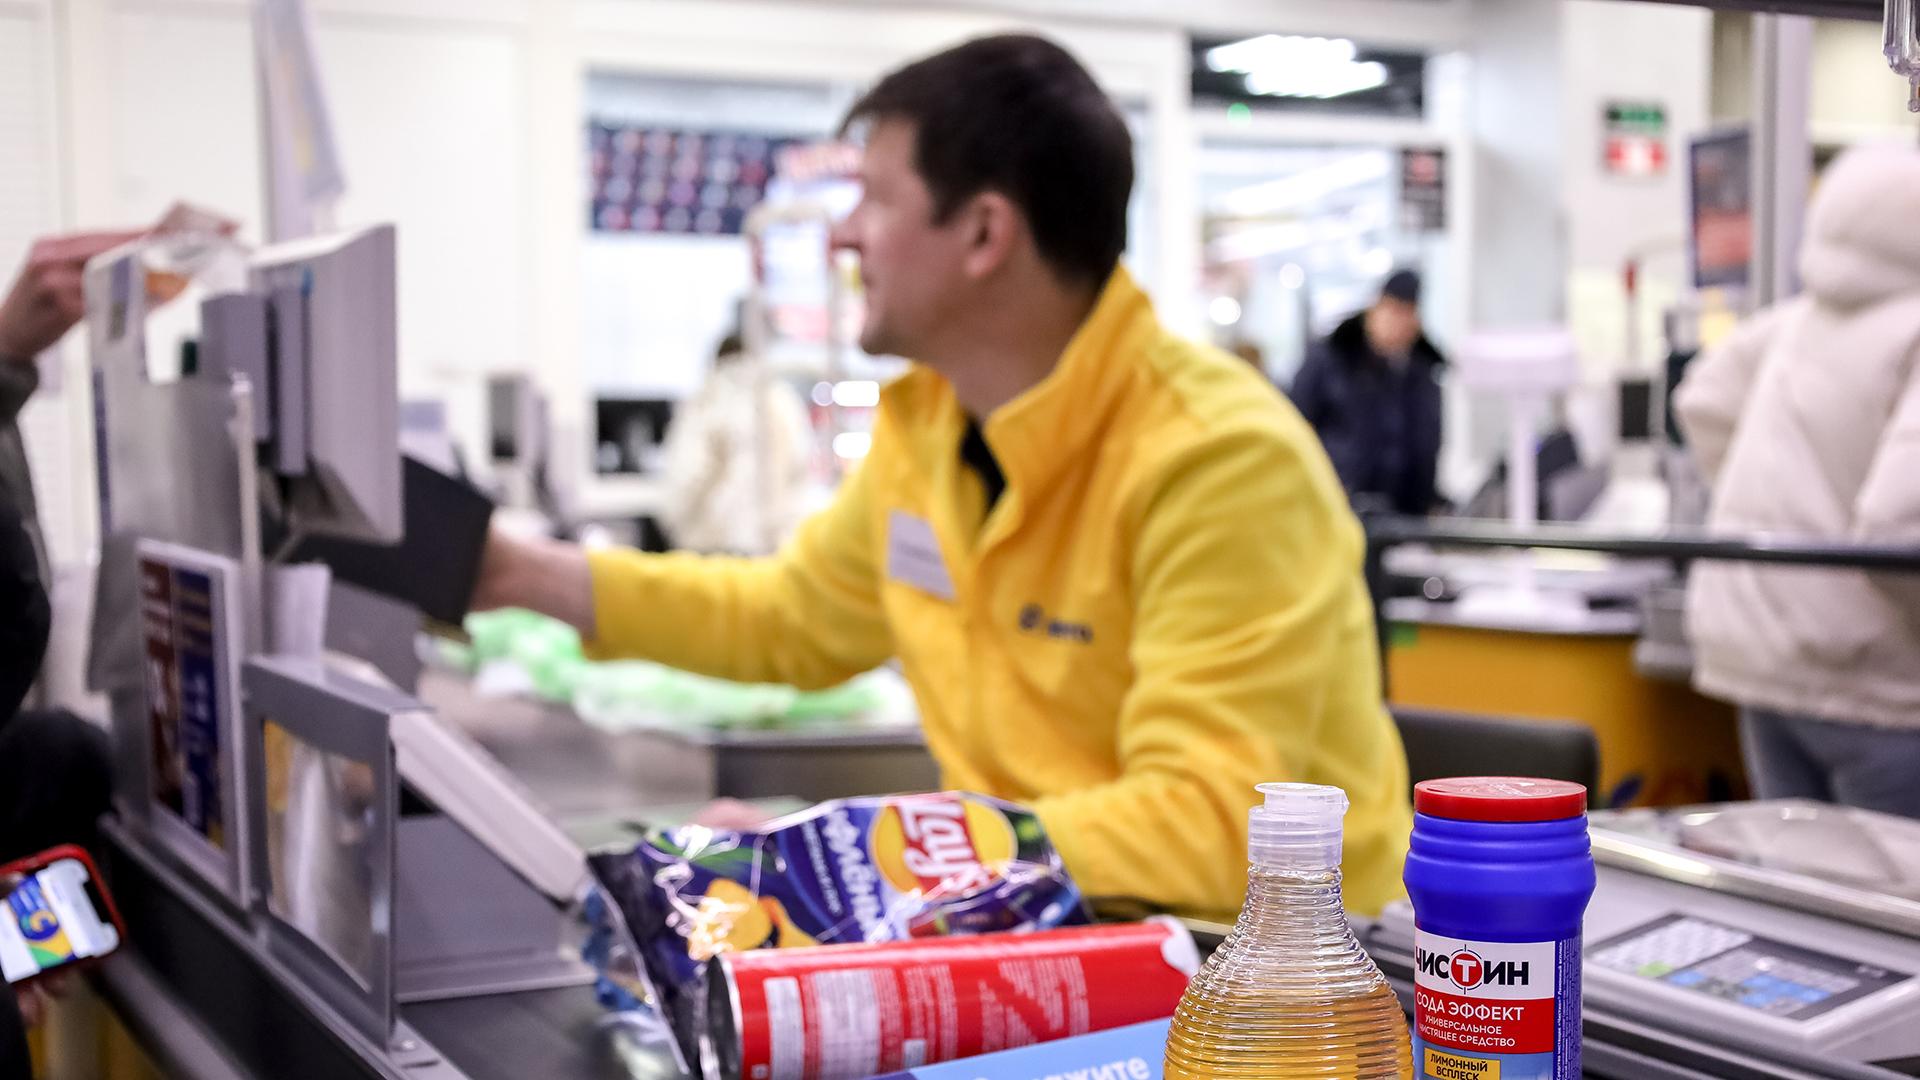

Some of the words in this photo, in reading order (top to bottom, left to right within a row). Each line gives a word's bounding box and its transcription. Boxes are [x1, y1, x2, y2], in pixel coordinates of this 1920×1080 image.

[1415, 945, 1529, 986] ЧИСТИН
[1416, 991, 1445, 1014] СОДА
[1448, 1001, 1524, 1021] ЭФФЕКТ
[1419, 1022, 1457, 1042] ЧИСТЯЩЕЕ
[1459, 1033, 1516, 1047] СРЕДСТВО
[1425, 1014, 1502, 1035] УНИВЕРСАЛЬНОЕ
[1430, 1053, 1488, 1072] ЛИМОННЫЙ
[1436, 1065, 1480, 1080] ВСПЛЕСК
